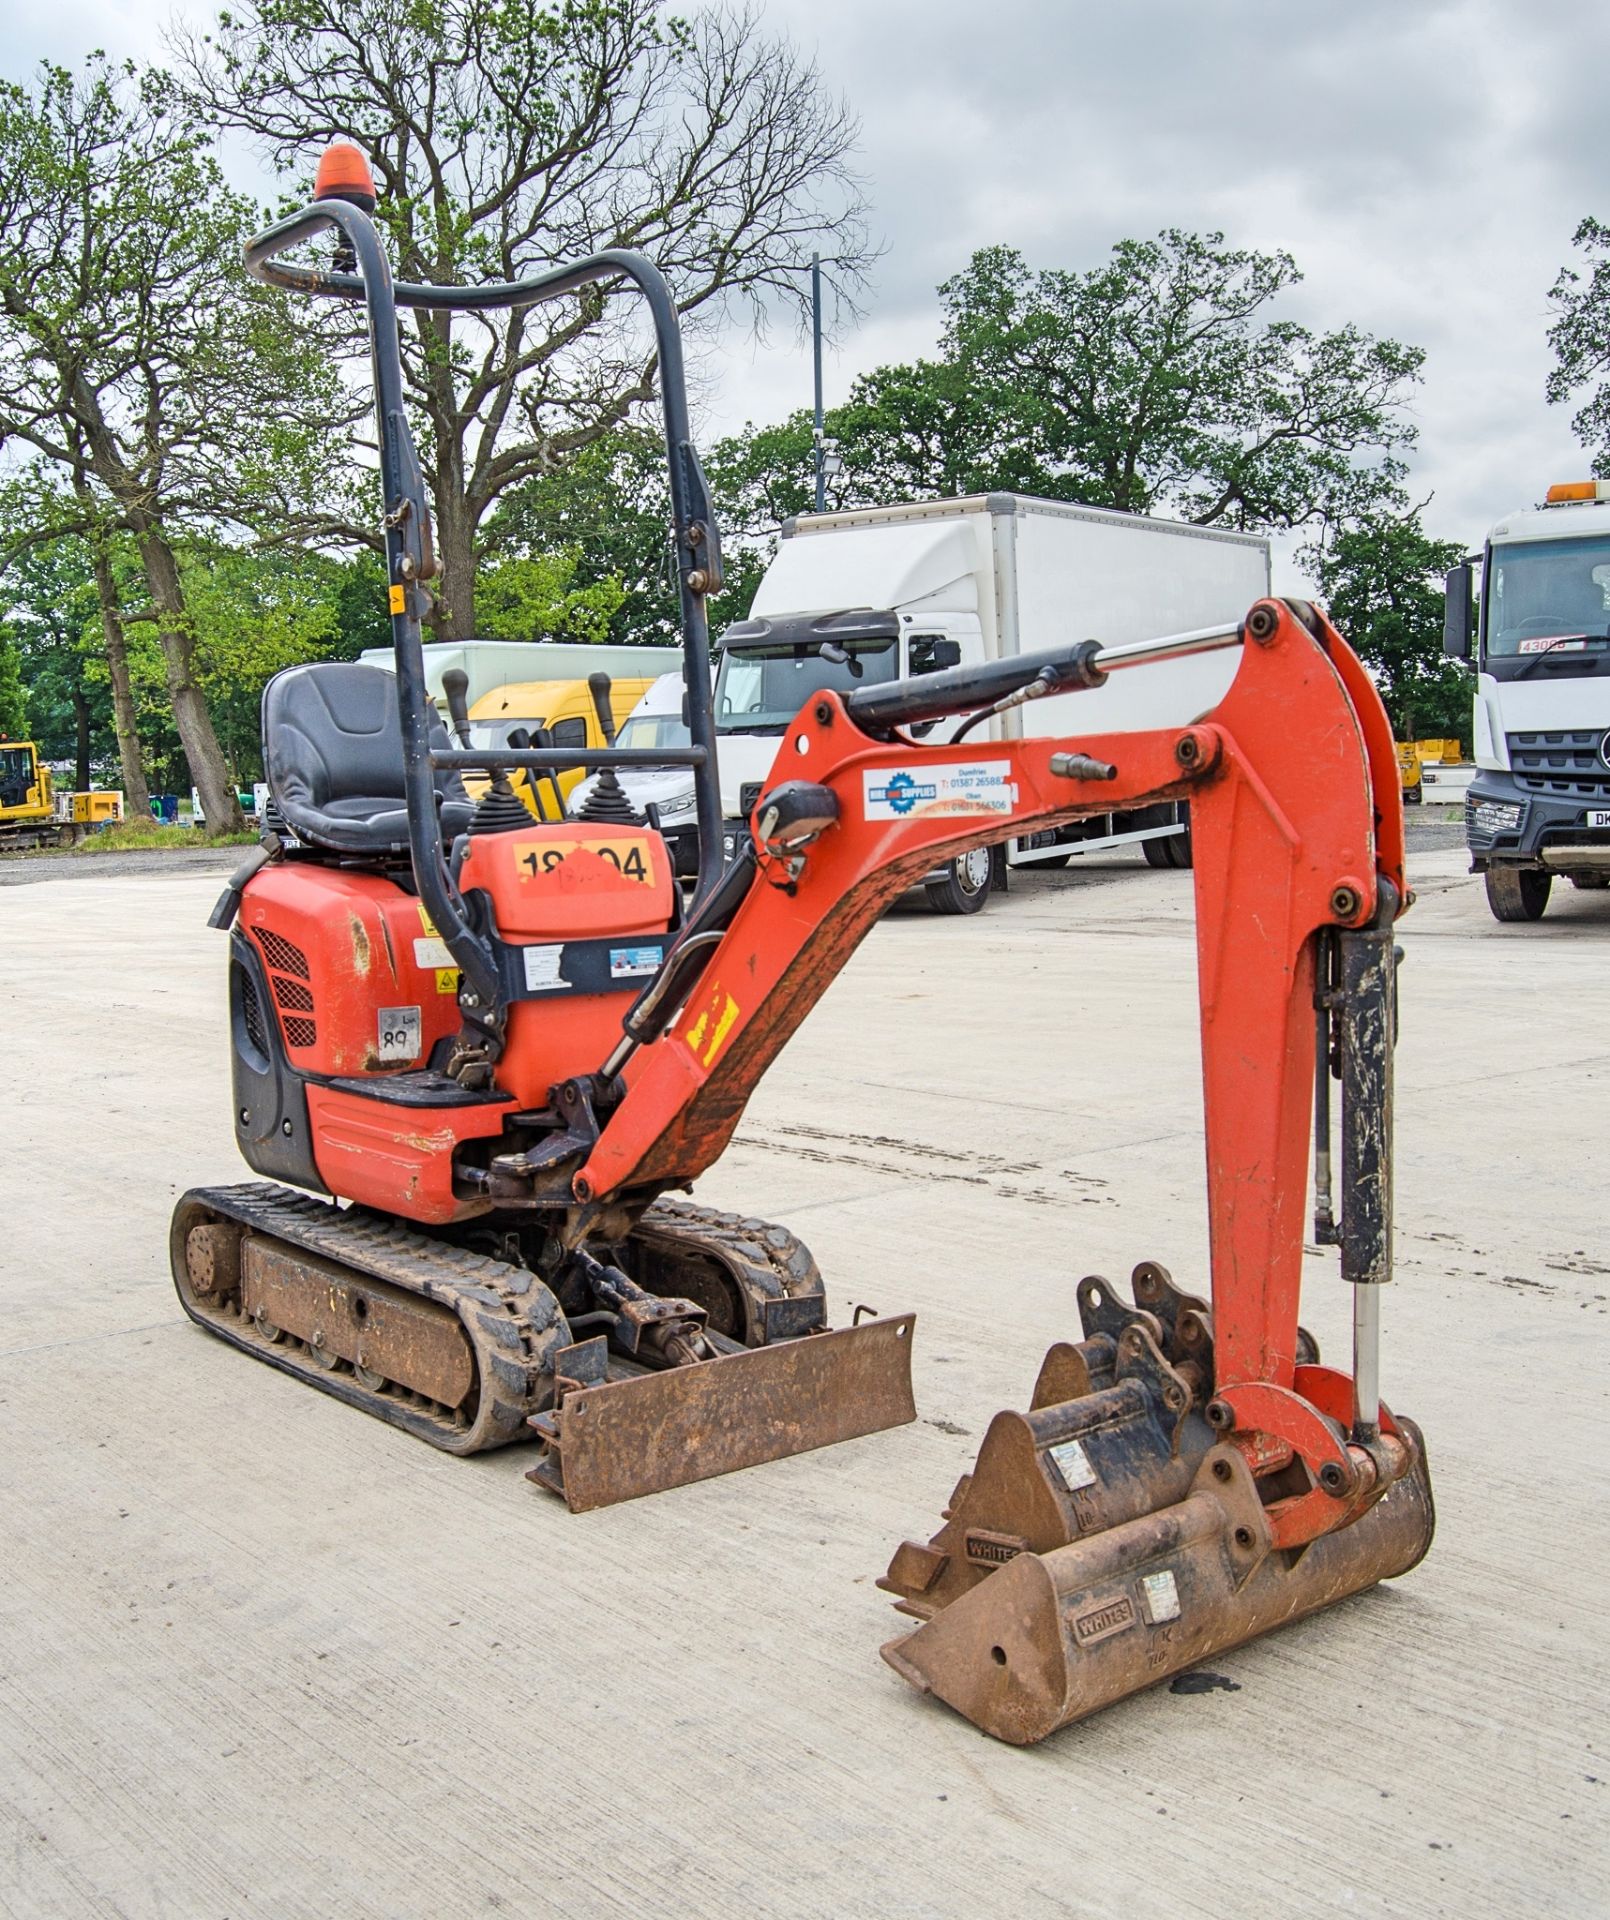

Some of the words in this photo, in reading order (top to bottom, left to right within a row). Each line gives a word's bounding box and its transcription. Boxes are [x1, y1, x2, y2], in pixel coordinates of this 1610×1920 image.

[958, 768, 987, 777] Dumfries
[950, 777, 974, 789] 01387
[901, 785, 936, 799] SUPPLIES
[965, 792, 982, 800] Oban
[1077, 1602, 1130, 1637] WHITES
